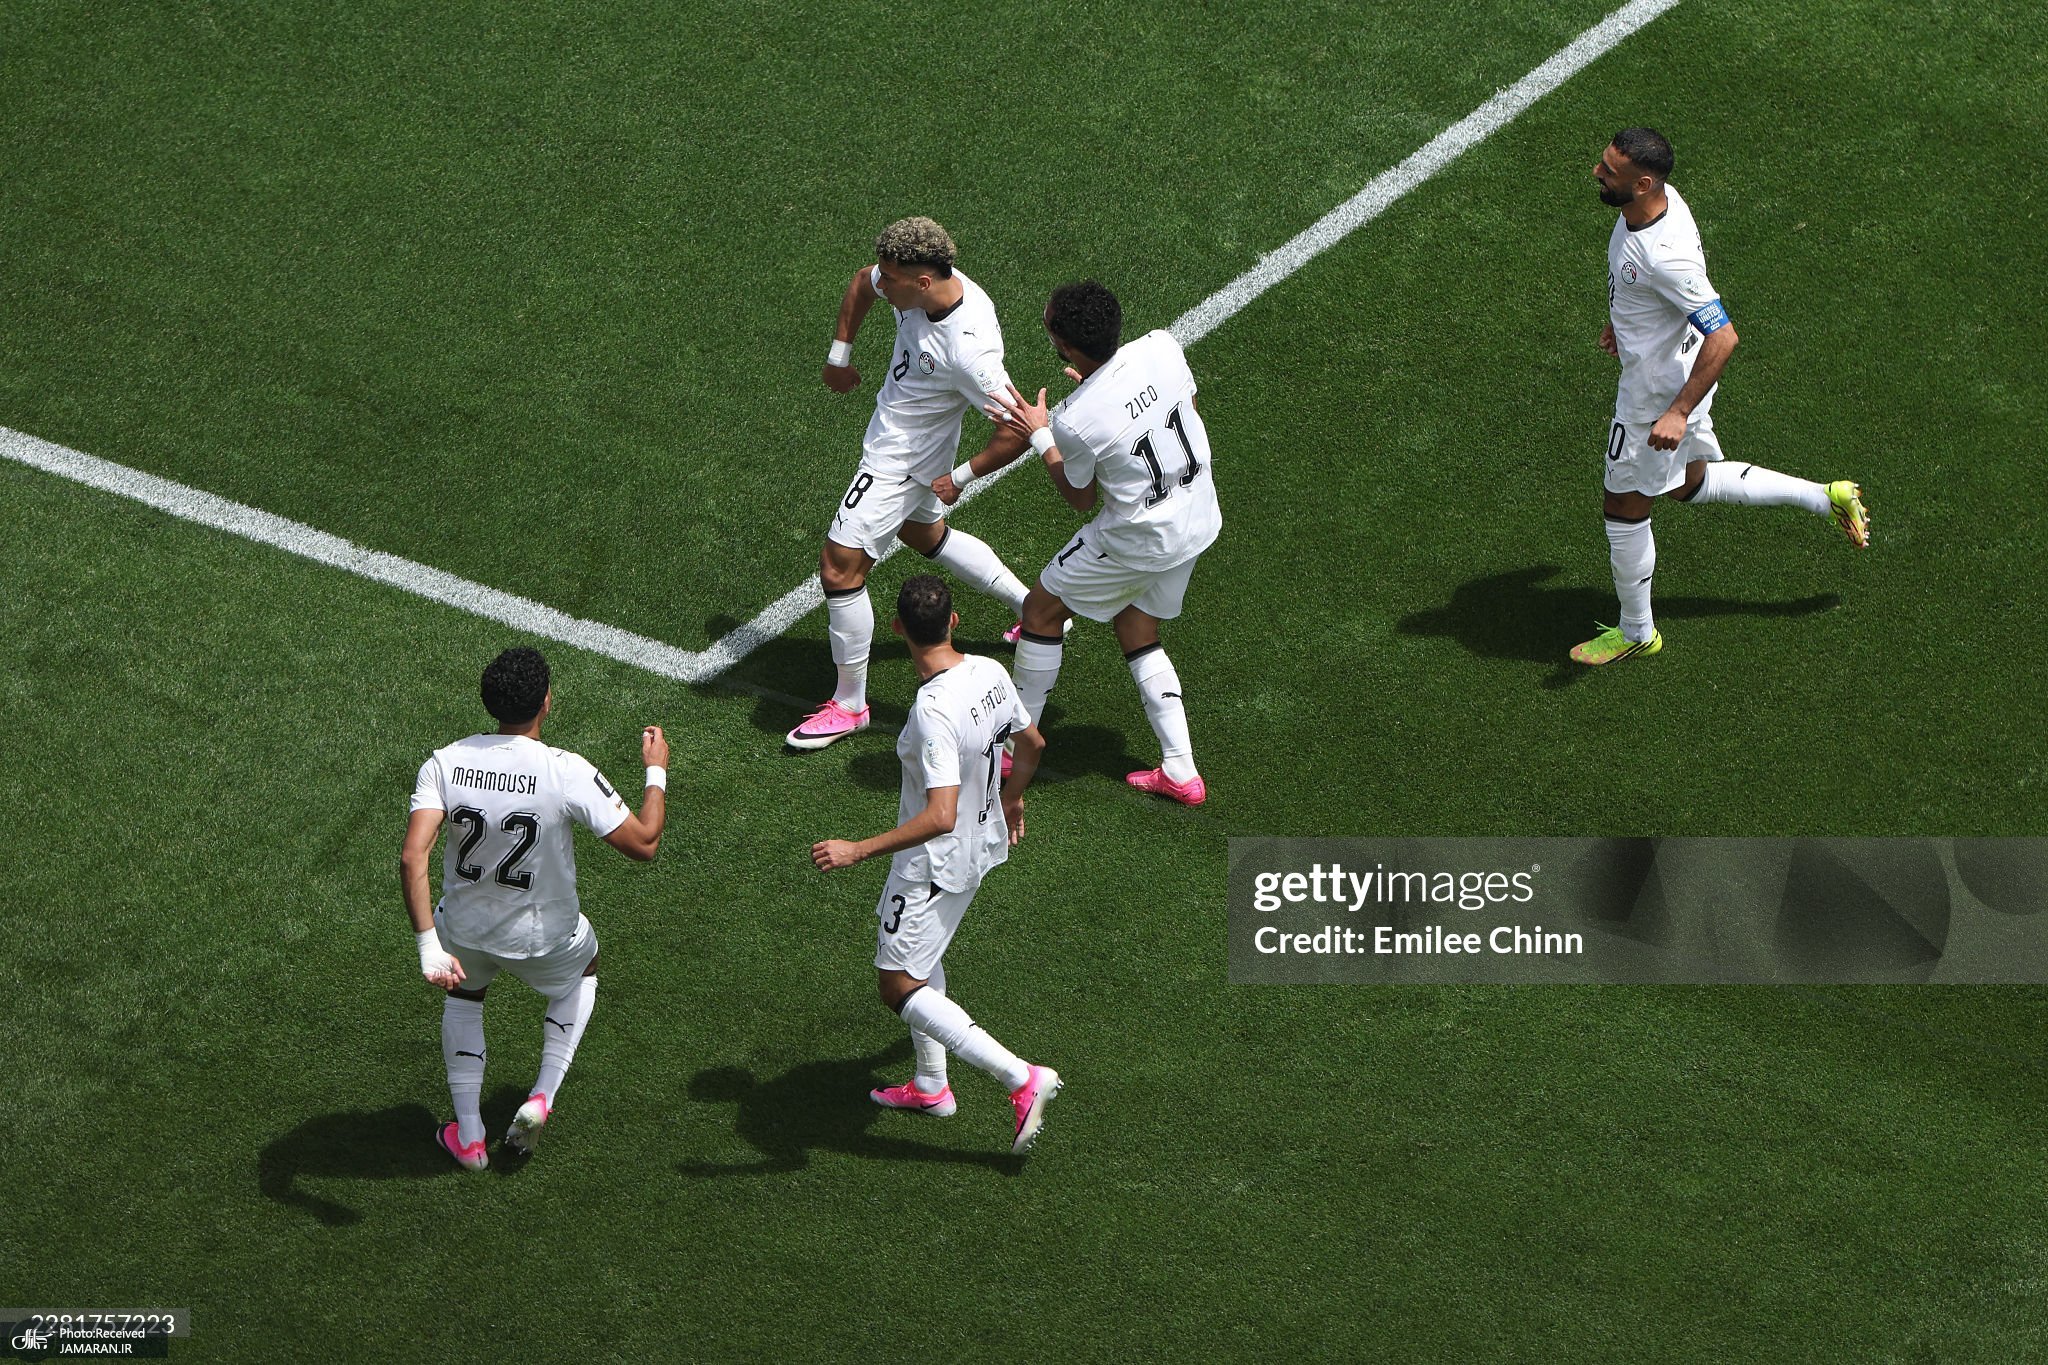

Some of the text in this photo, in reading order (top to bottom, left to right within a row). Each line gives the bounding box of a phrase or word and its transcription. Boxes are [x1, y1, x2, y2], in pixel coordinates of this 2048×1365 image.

[1699, 307, 1721, 323] UNITES
[893, 350, 910, 381] 8
[1125, 385, 1158, 420] ZICO
[1130, 400, 1203, 510] 11
[844, 472, 874, 509] 8
[451, 766, 537, 795] MARMOUSH
[451, 805, 540, 892] 22
